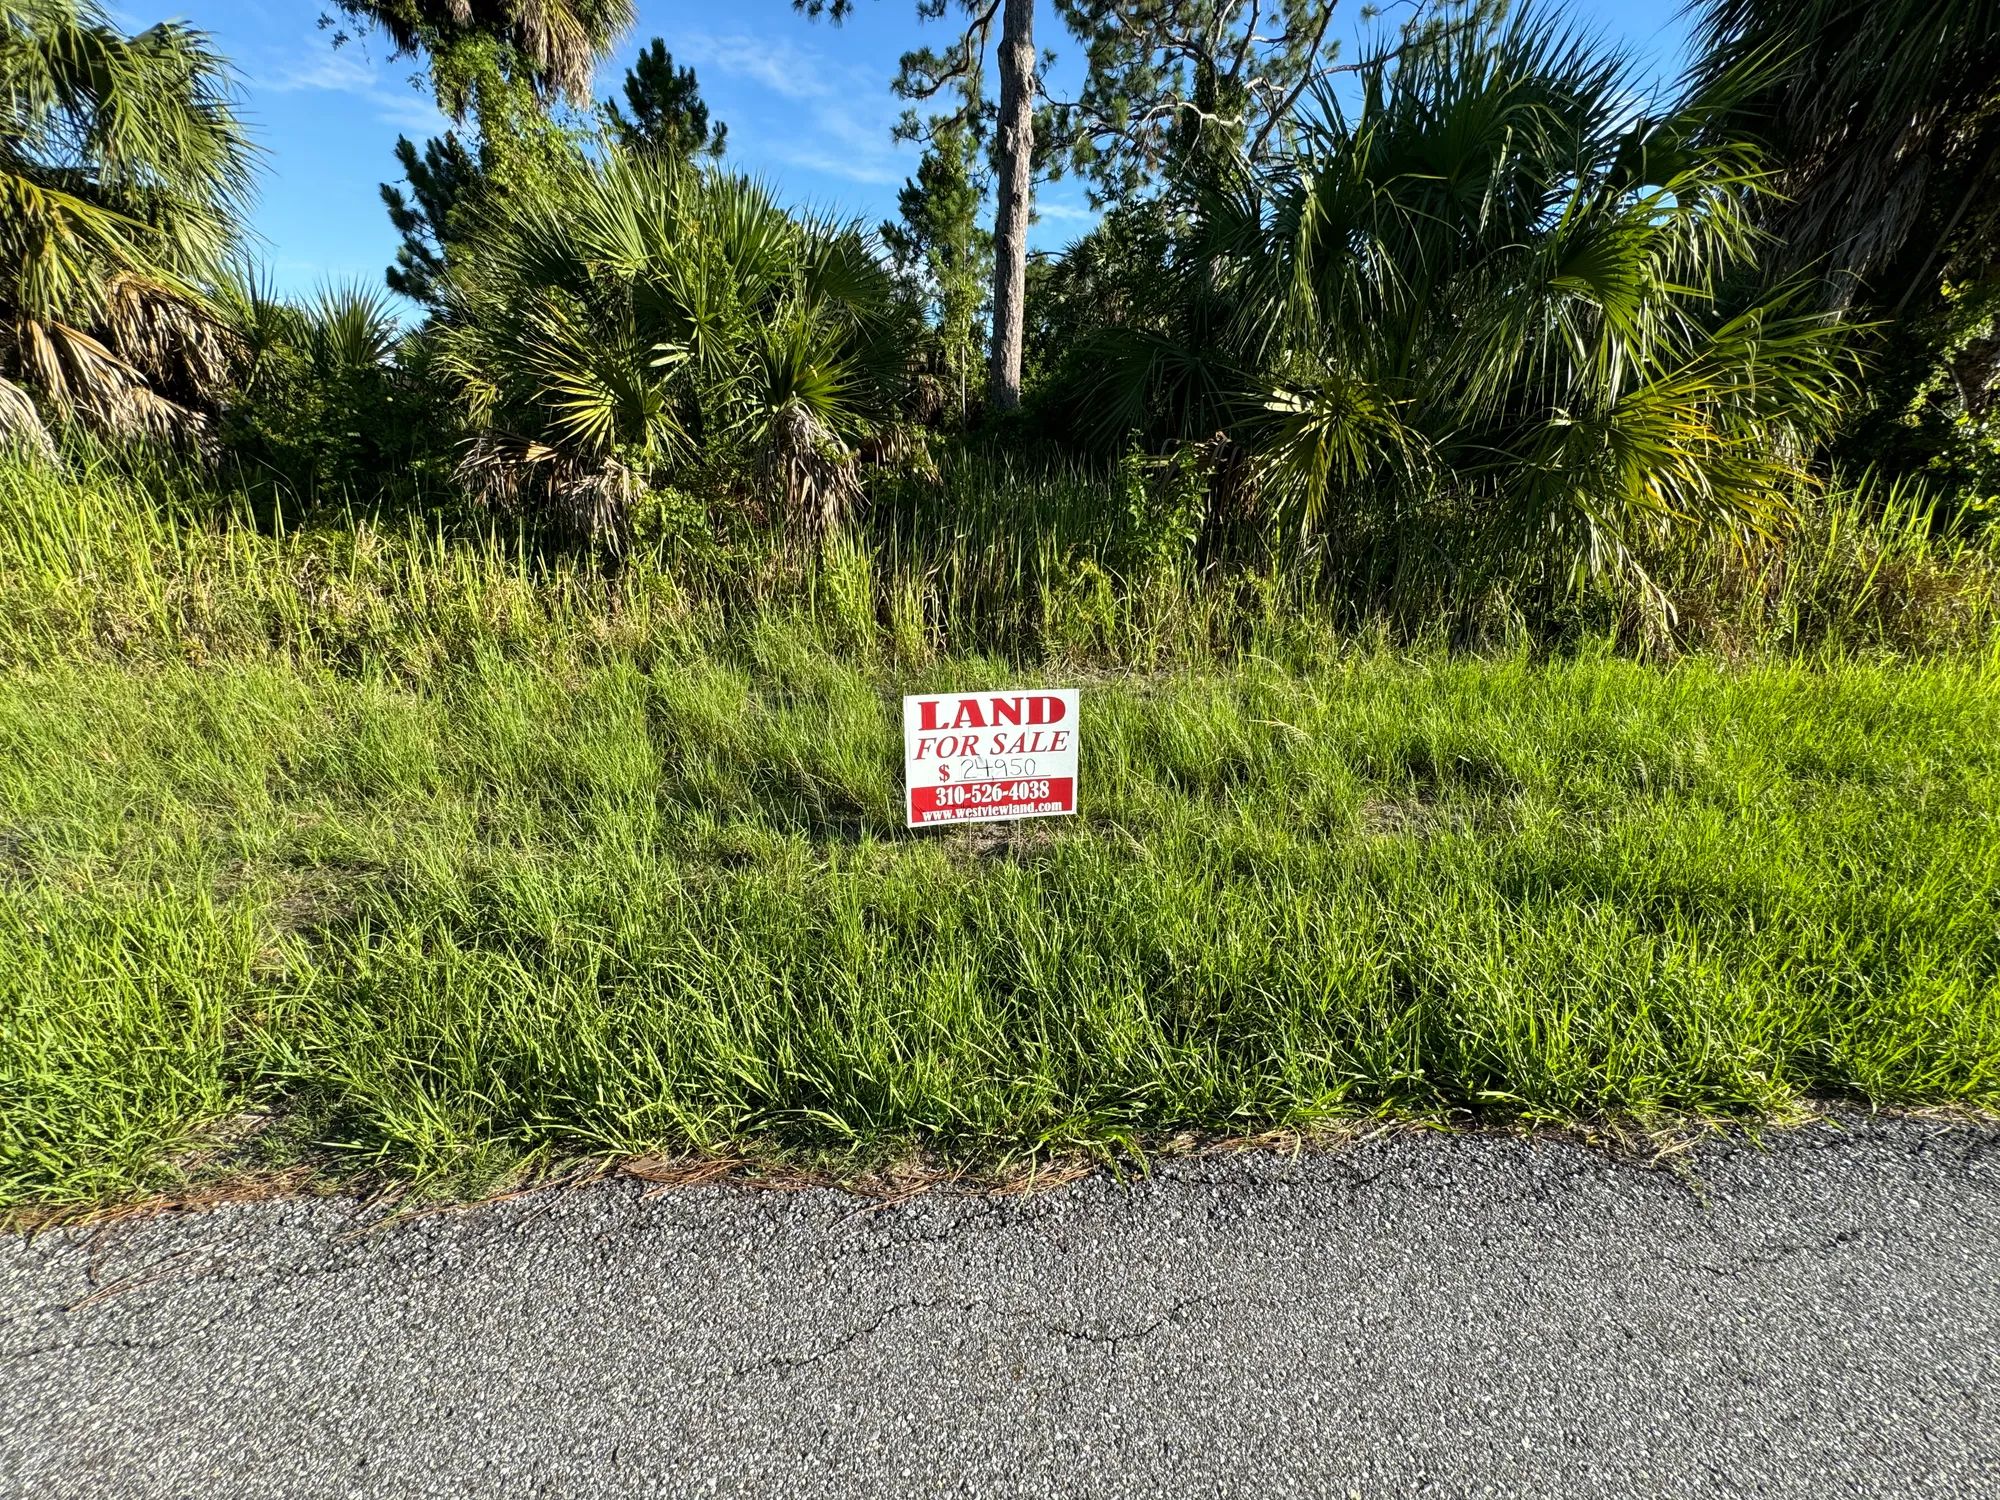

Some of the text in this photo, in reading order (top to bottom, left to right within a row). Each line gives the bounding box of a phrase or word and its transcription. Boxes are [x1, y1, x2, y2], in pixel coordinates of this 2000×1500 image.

[918, 696, 1066, 731] LAND
[913, 731, 1070, 760] FOR SALE
[938, 764, 950, 782] $
[935, 780, 1050, 806] 310-526-4038
[922, 801, 1062, 822] www.westviewland.com
